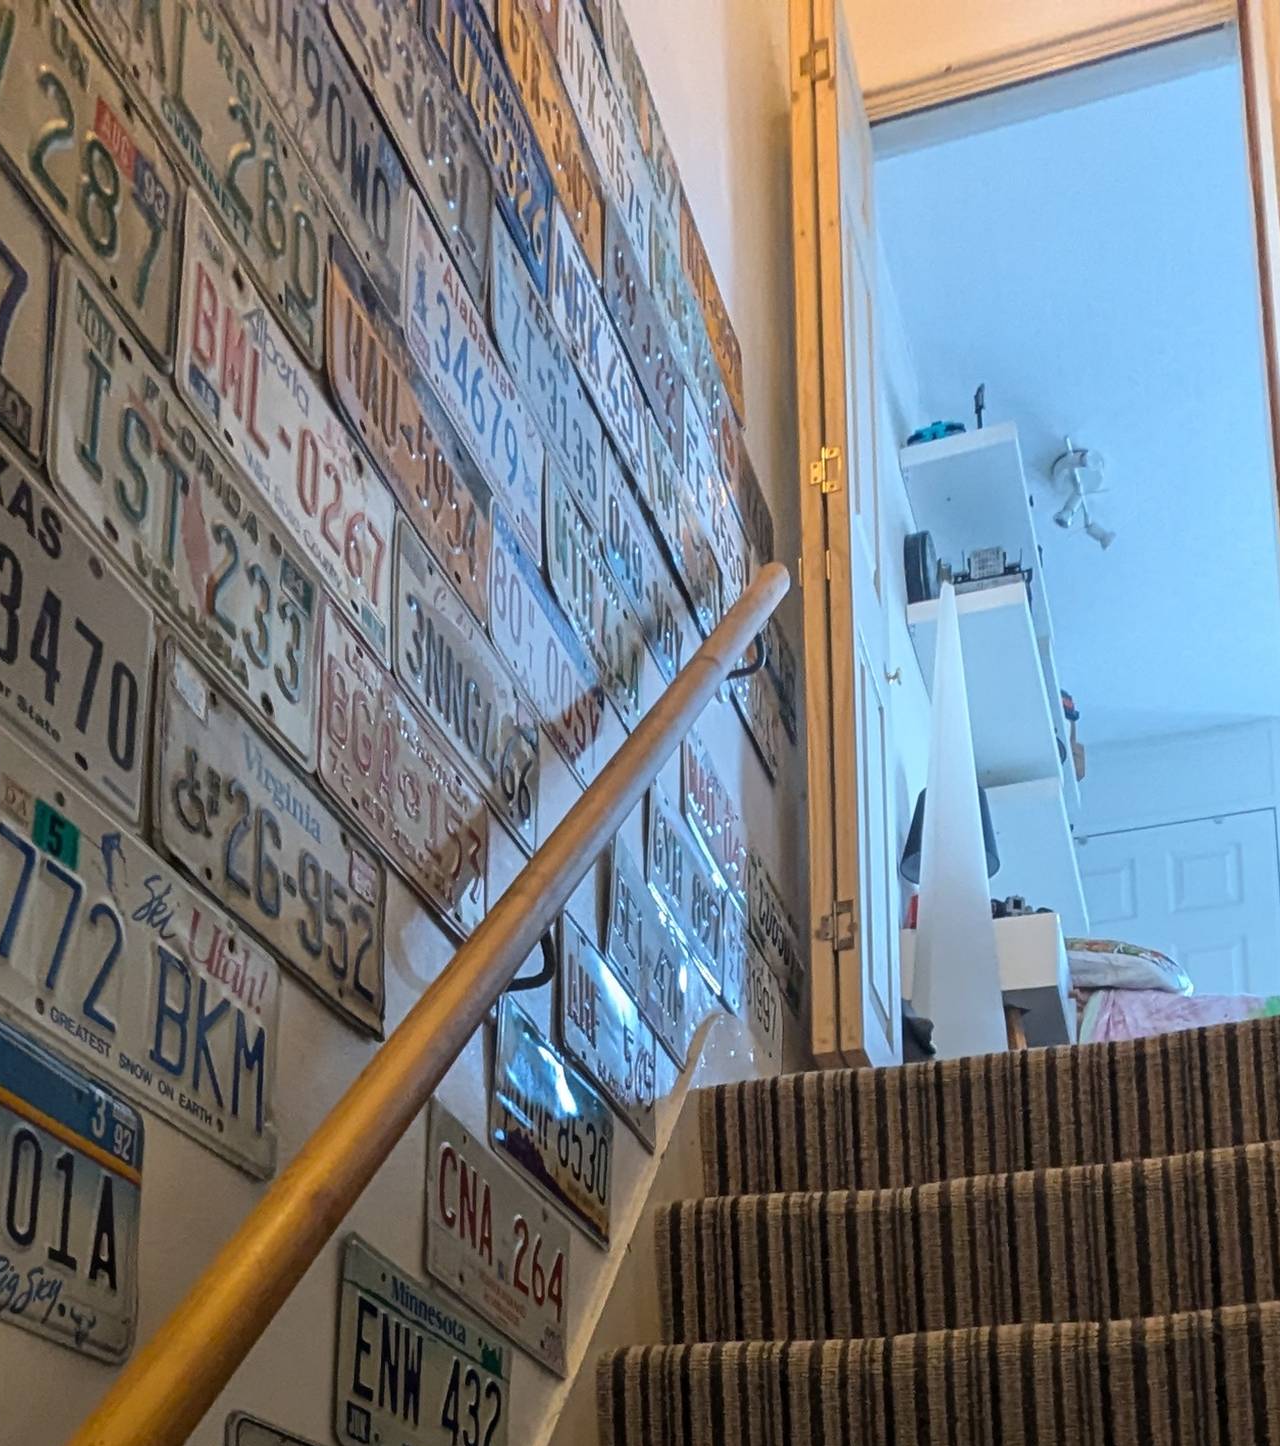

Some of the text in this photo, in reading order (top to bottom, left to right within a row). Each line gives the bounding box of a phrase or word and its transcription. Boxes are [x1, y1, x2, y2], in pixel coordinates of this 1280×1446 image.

[591, 47, 624, 143] TEXAS
[31, 73, 160, 305] 287
[160, 96, 249, 245] GWINNETT
[225, 105, 318, 308] 260
[241, 280, 308, 415] Alberta
[442, 265, 507, 396] Alabama
[526, 282, 568, 383] TEXAS
[555, 233, 600, 378] NRK
[193, 267, 382, 603] BML-0267
[435, 292, 517, 483] 34679
[79, 352, 300, 687] IST 233
[142, 377, 257, 542] FLORIDA
[493, 546, 522, 644] 80
[17, 695, 60, 741] State
[47, 814, 63, 855] 5
[242, 732, 320, 843] Virginia
[132, 861, 267, 1007] Ski Utah!
[224, 810, 375, 1010] 26-952
[49, 1005, 212, 1125] GREATEST SNOW ON EARTH
[150, 950, 264, 1131] BKM
[91, 1084, 109, 1136] 3
[113, 1123, 131, 1159] 92
[439, 1147, 492, 1263] CNA
[513, 1218, 562, 1320] 264
[353, 1297, 422, 1423] ENW
[392, 1276, 465, 1343] Minnesota
